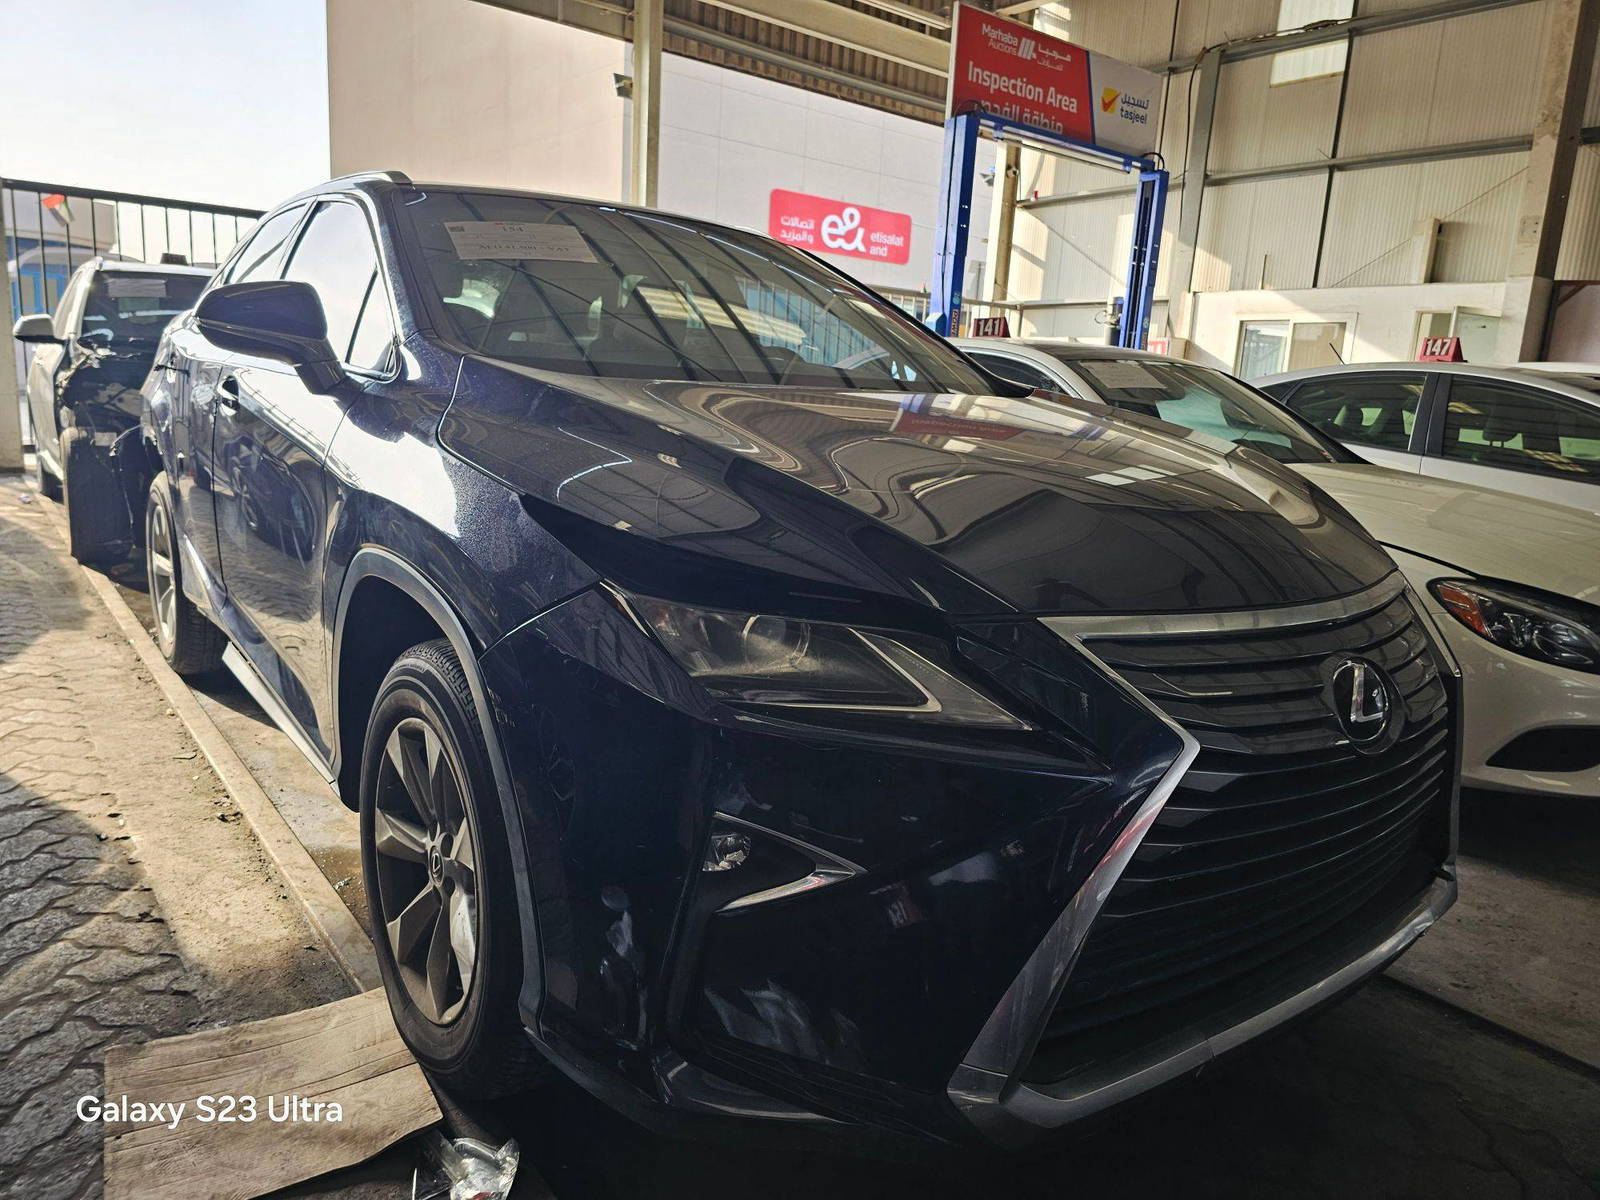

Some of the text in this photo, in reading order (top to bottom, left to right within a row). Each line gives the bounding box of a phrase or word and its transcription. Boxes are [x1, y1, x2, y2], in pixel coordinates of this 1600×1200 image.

[982, 23, 1018, 46] Marhaba
[988, 38, 1017, 56] Auctions
[968, 60, 1077, 113] Inspection Area
[1121, 93, 1149, 110] تسجيل
[1120, 107, 1147, 124] tasjeel
[870, 231, 904, 247] etisalat
[869, 245, 888, 257] and
[979, 318, 1001, 336] 141
[1425, 338, 1451, 356] 147
